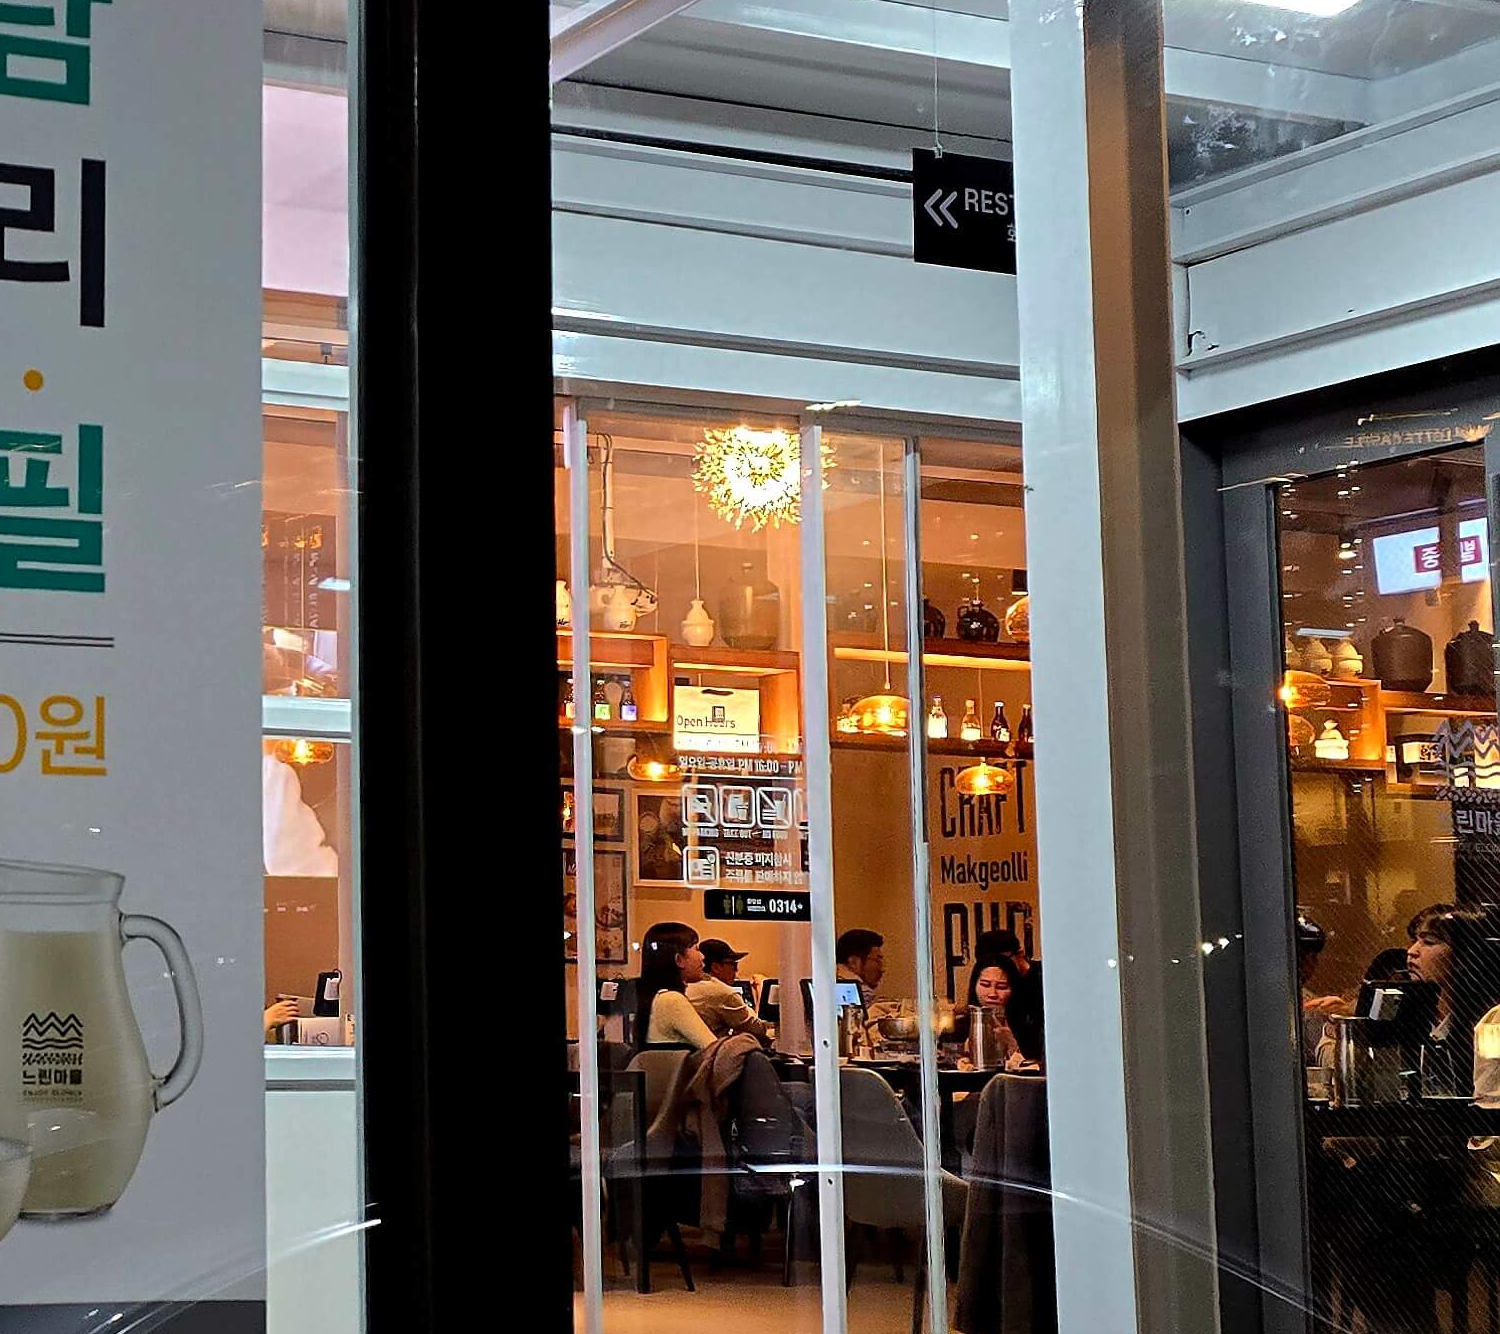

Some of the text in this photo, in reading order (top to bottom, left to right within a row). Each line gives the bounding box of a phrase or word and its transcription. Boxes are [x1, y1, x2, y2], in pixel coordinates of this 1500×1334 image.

[964, 187, 1015, 216] RES
[677, 714, 703, 729] Open
[940, 851, 1028, 891] Makgeolli
[22, 1069, 83, 1085] 느린마을
